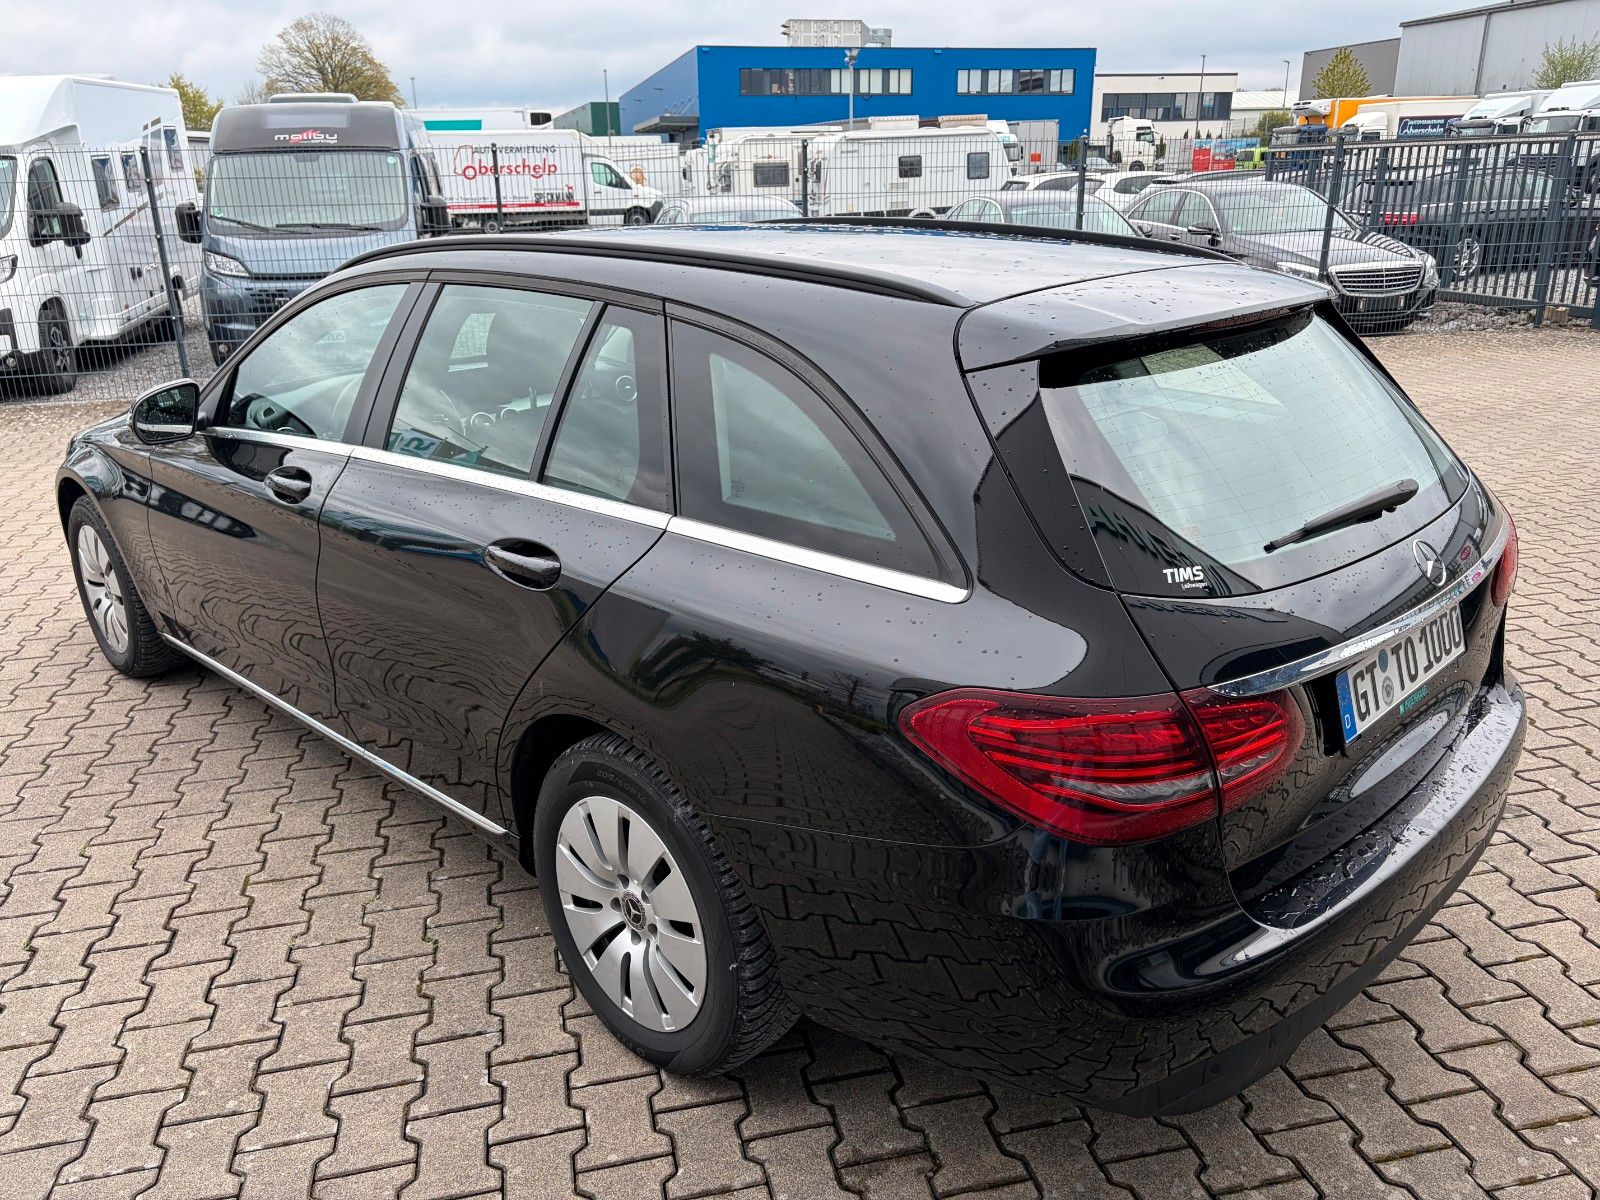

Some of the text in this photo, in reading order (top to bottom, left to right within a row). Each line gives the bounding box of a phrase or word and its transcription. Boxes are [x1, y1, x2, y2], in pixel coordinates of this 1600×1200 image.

[274, 132, 338, 141] malibu
[1162, 565, 1204, 584] TIMS
[1352, 660, 1380, 722] GT
[1390, 635, 1419, 691] TO
[1419, 604, 1462, 674] 1000
[1344, 713, 1351, 730] D
